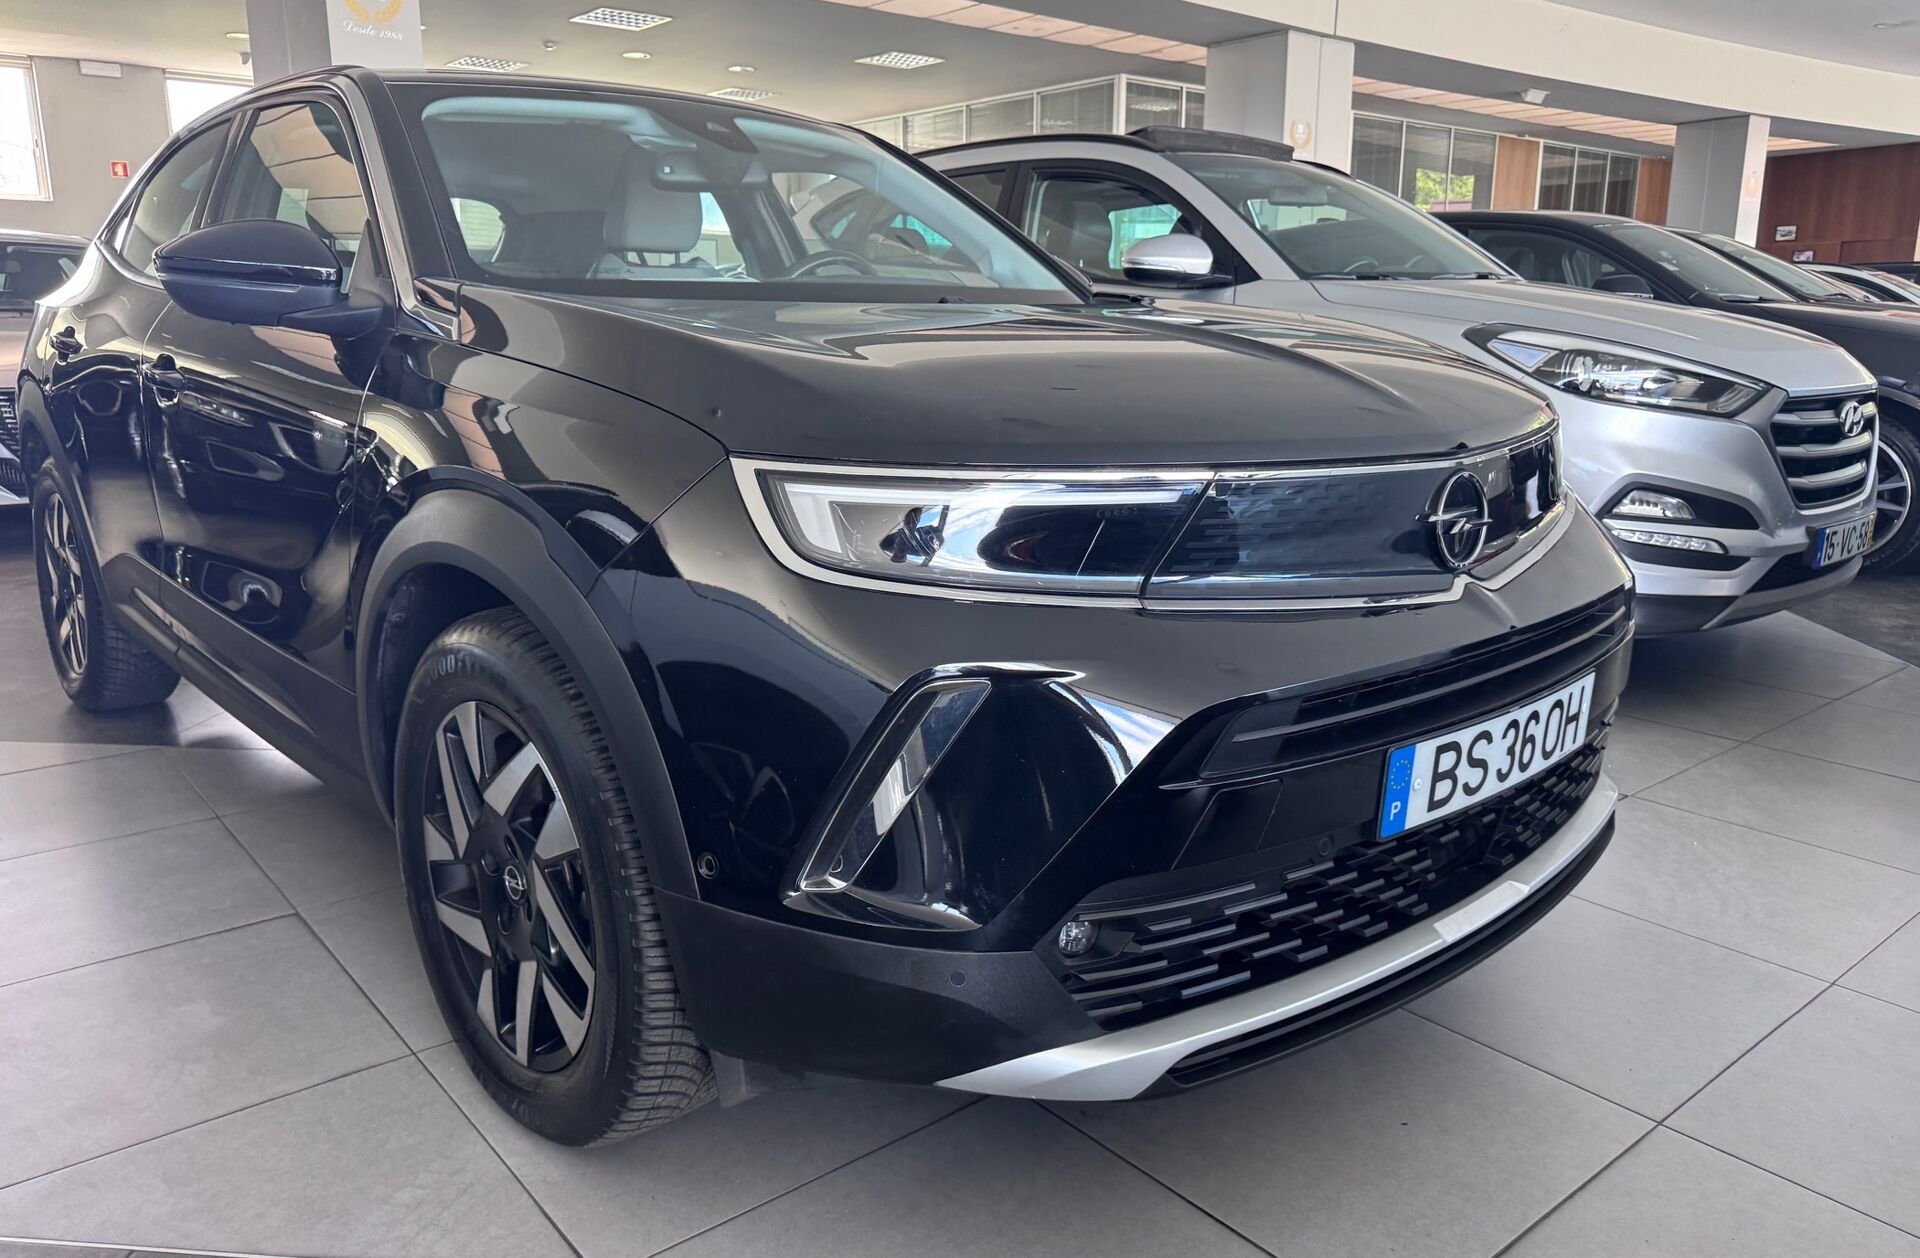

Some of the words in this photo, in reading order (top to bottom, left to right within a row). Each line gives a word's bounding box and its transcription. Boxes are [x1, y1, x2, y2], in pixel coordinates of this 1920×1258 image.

[342, 20, 377, 36] Desde
[379, 30, 404, 41] 1988
[1389, 801, 1402, 821] P
